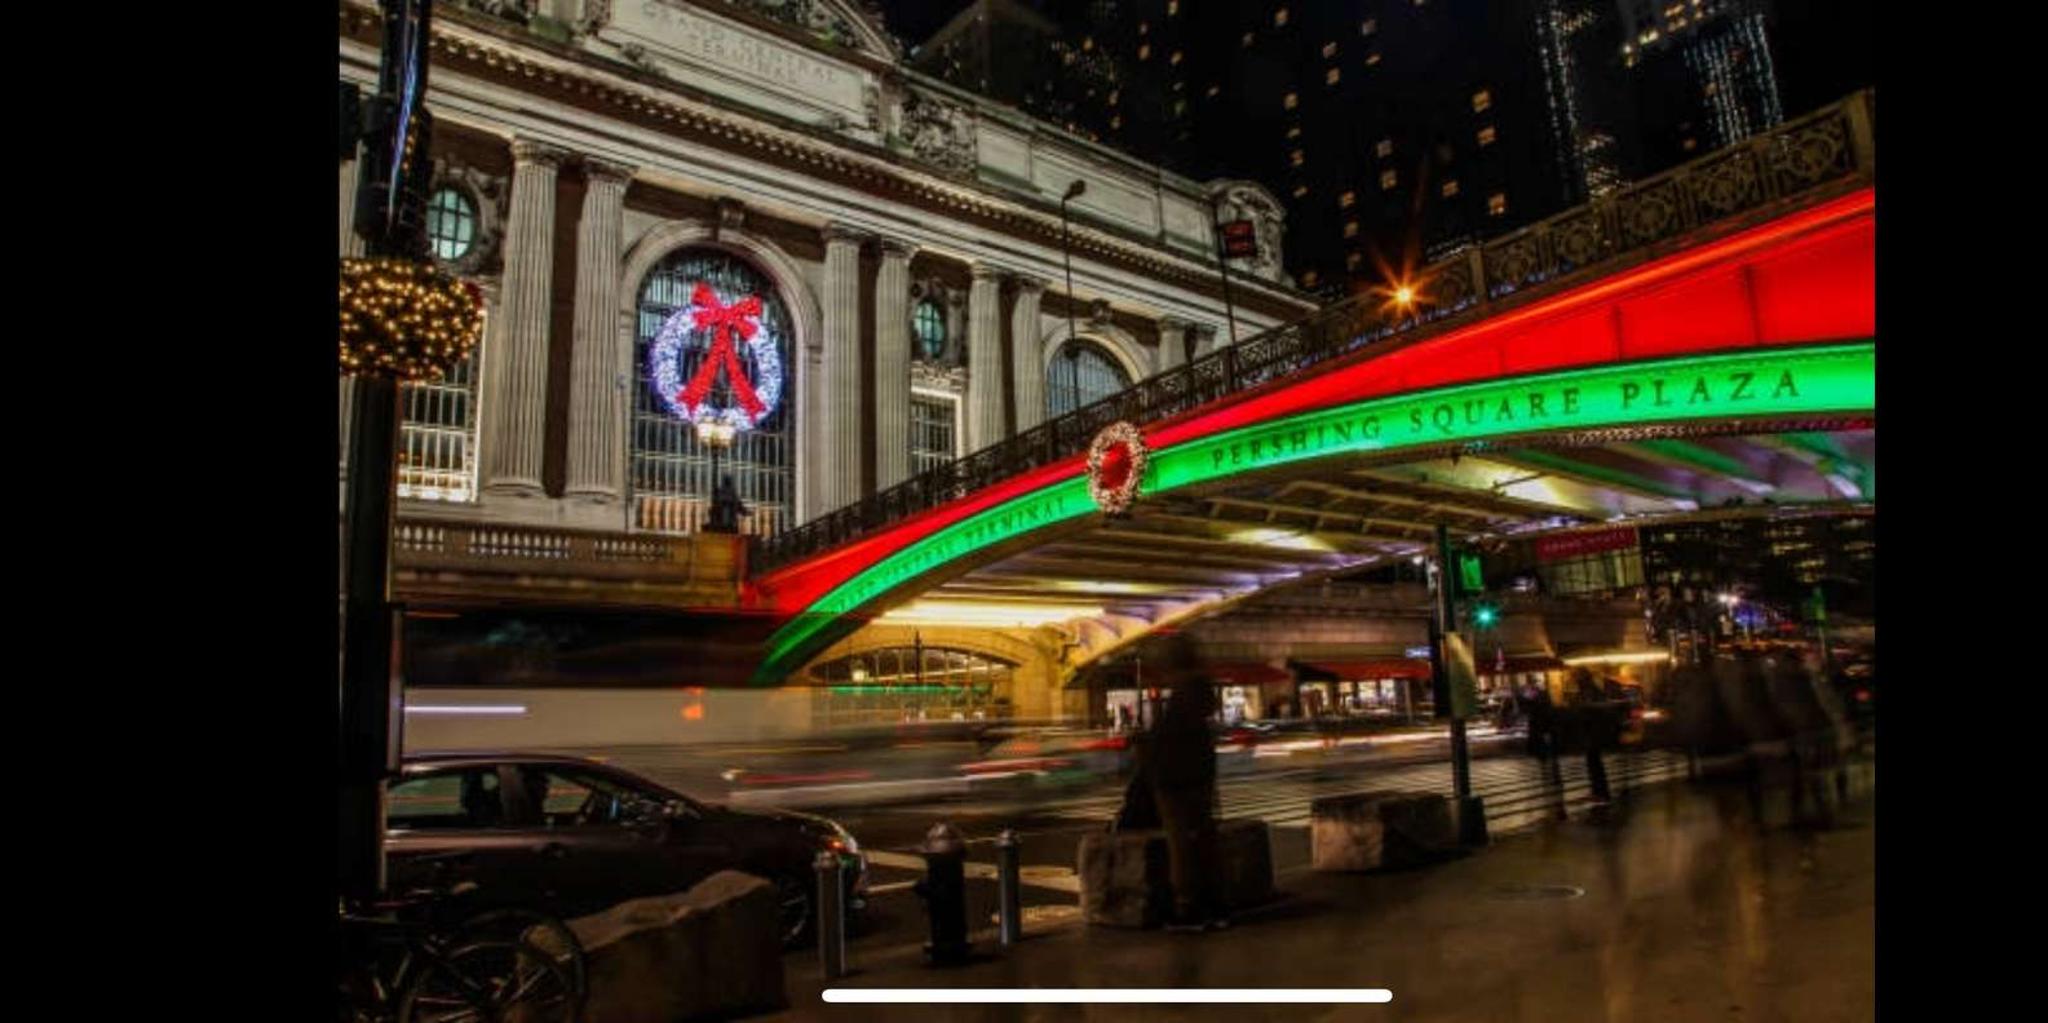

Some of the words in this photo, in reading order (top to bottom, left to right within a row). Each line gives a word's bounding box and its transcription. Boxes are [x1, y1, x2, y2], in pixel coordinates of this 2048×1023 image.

[642, 3, 725, 41] GRAND
[740, 38, 834, 80] CENTRAL
[1212, 417, 1382, 468] PERSHING
[1409, 388, 1582, 434] SQUARE
[1621, 369, 1802, 409] PLAZA
[965, 496, 1065, 544] TERMINAL
